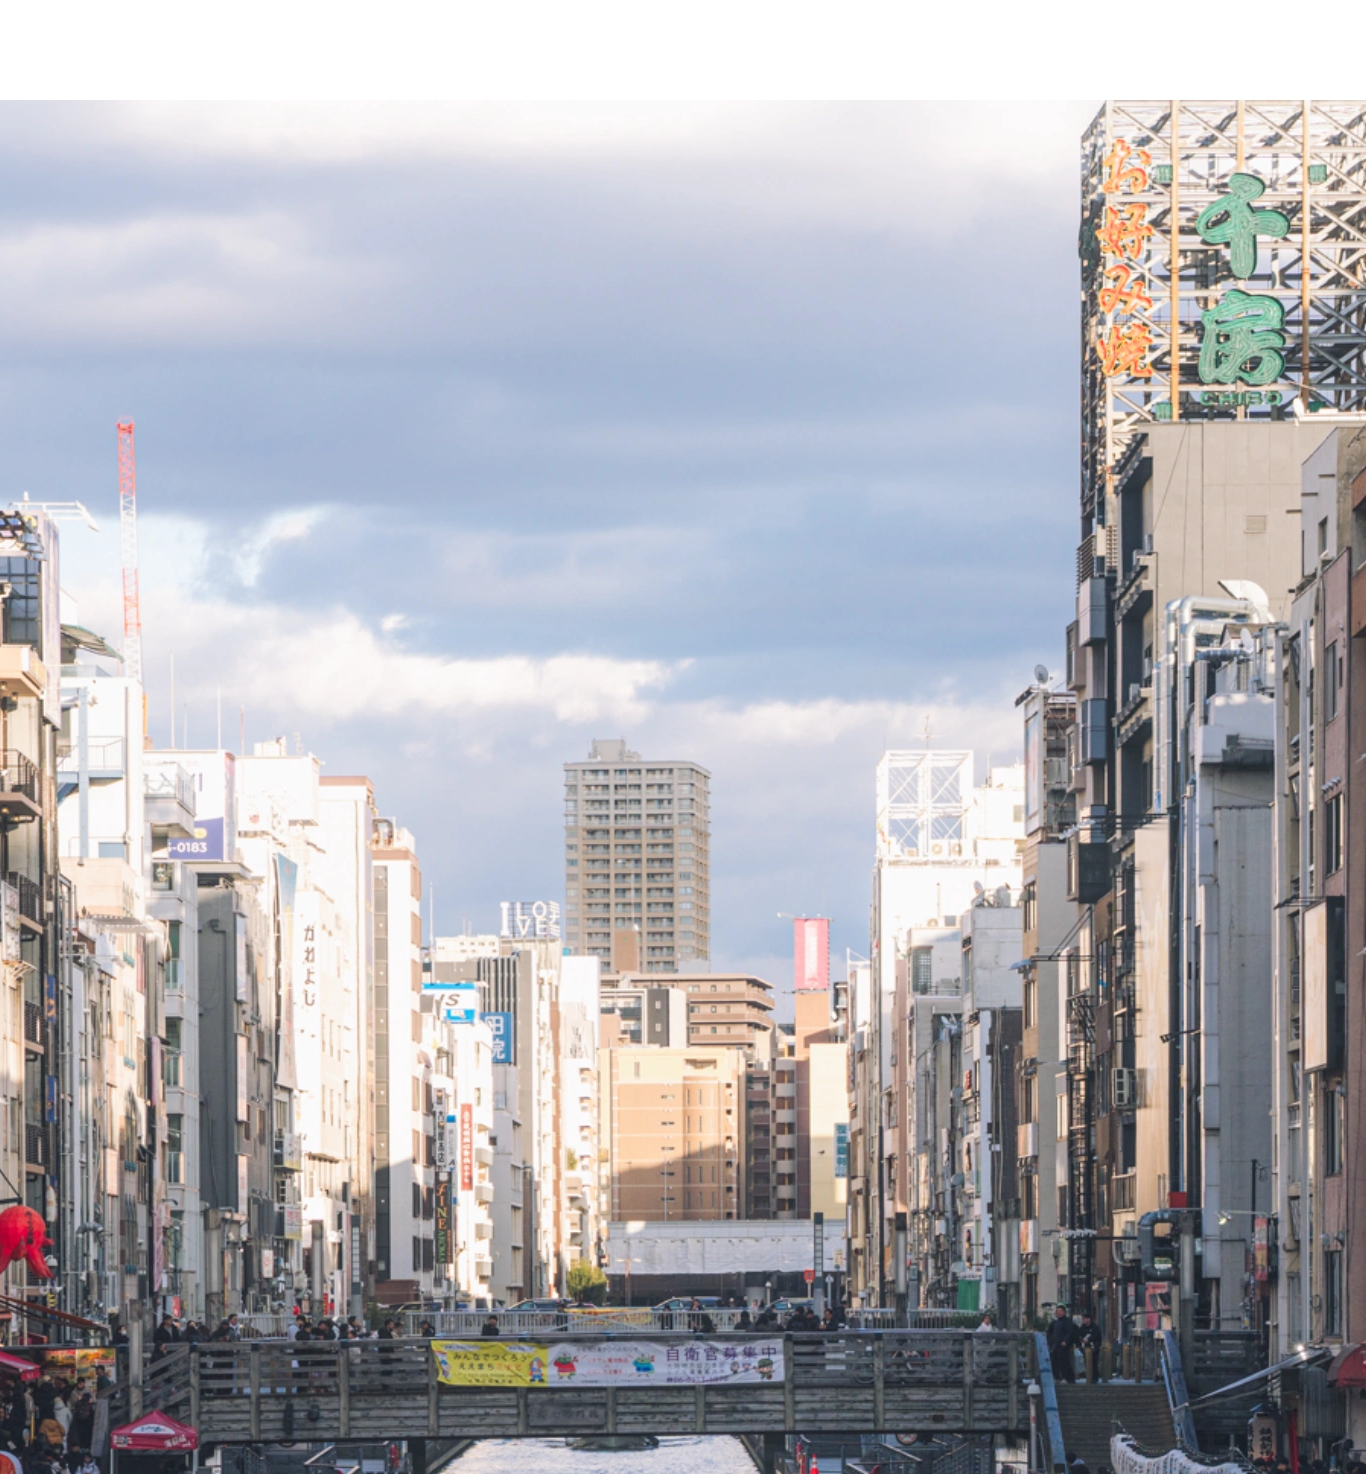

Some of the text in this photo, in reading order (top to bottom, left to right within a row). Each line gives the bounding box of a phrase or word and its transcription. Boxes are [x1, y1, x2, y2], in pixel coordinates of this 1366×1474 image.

[1096, 139, 1154, 378] お好み焼
[1196, 171, 1292, 386] 千房
[1199, 388, 1285, 407] CHIBO
[452, 1352, 530, 1363] みんなでつくろう
[666, 1345, 778, 1363] 自衛官募集中
